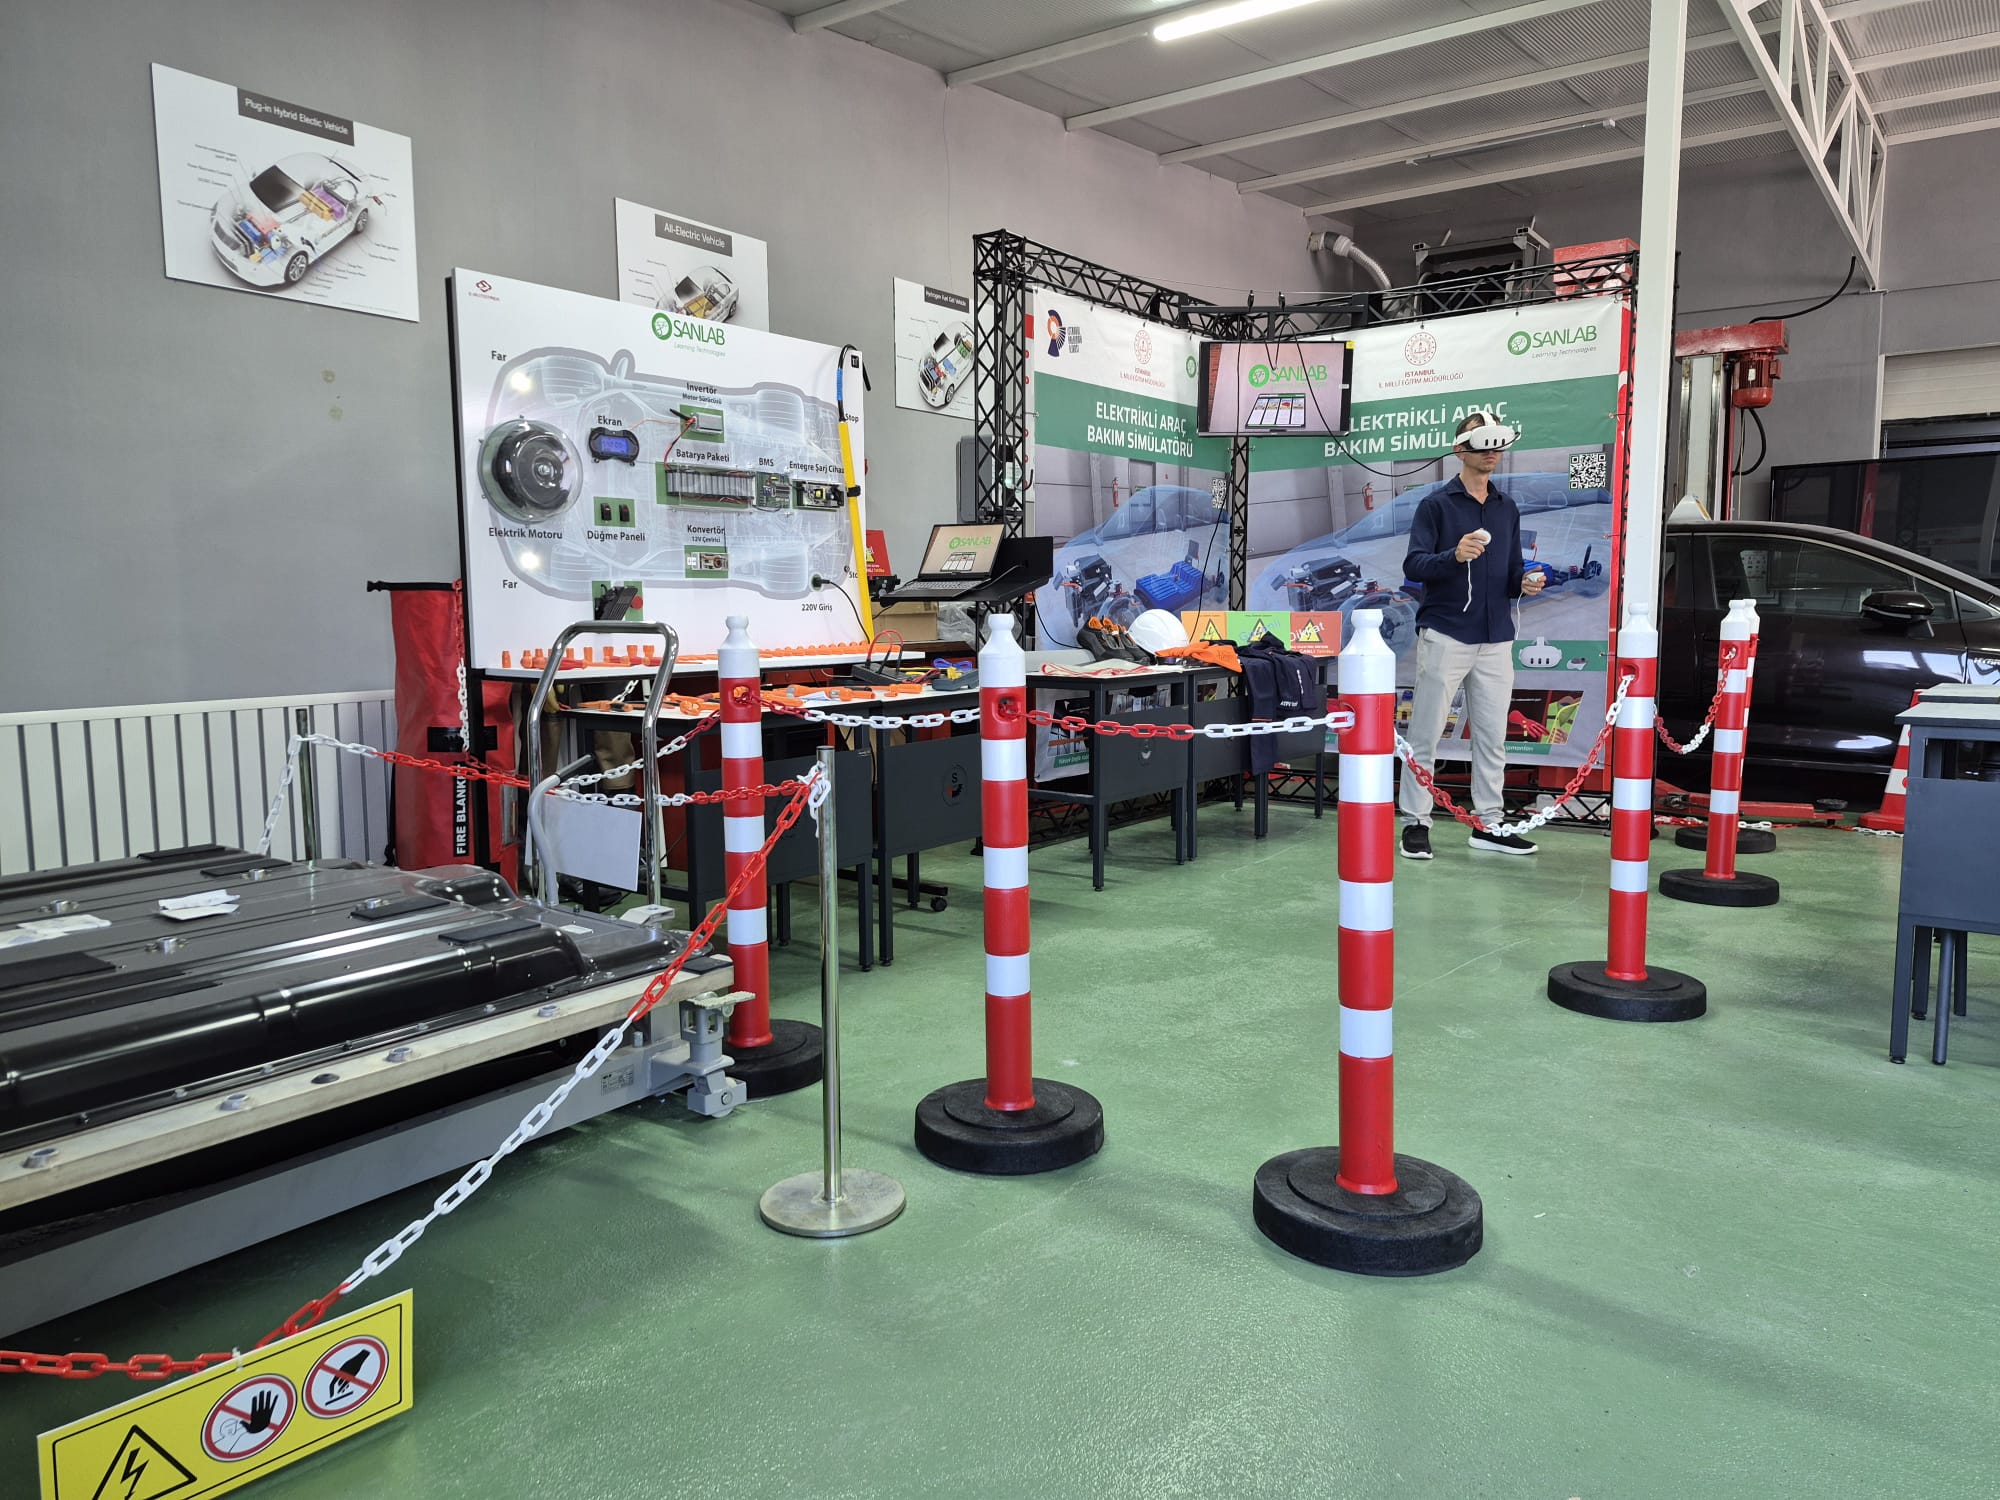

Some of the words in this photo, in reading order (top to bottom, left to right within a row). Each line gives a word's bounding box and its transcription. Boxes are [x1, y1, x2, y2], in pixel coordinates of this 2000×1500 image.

[244, 97, 272, 113] Plug-in
[273, 106, 298, 121] Hybrid
[323, 120, 349, 135] Vehicle
[664, 222, 700, 242] All-Electric
[702, 232, 725, 249] Vehicle
[673, 319, 726, 346] SANLAB
[1532, 325, 1597, 349] SANLAB
[491, 350, 507, 361] Far
[1532, 350, 1558, 359] Learning
[1270, 365, 1328, 382] SANLAB
[597, 415, 622, 427] Ekran
[845, 412, 859, 424] Stop
[1096, 401, 1158, 429] ELEKTRİKLİ
[1159, 414, 1187, 437] ARAÇ
[1350, 404, 1446, 433] LEKTRİKLİ
[1087, 425, 1125, 448] BAKIM
[1127, 429, 1193, 458] SİMÜLATÖRÜ
[1324, 437, 1386, 457] BAKIM
[676, 449, 706, 461] Batarya
[707, 452, 730, 463] Paketi
[759, 457, 774, 467] BMS
[789, 461, 815, 473] Entegre
[815, 464, 828, 474] Şarj
[488, 527, 526, 539] Elektrik
[528, 529, 563, 539] Motoru
[587, 530, 618, 542] Düğme
[620, 532, 646, 542] Paneli
[687, 524, 725, 536] Konvertör
[960, 536, 992, 547] SANLAB
[849, 571, 859, 579] Sto
[502, 579, 518, 589] Far
[818, 603, 833, 613] Giriş
[456, 764, 467, 823] BLANK
[456, 825, 467, 855] FIRE
